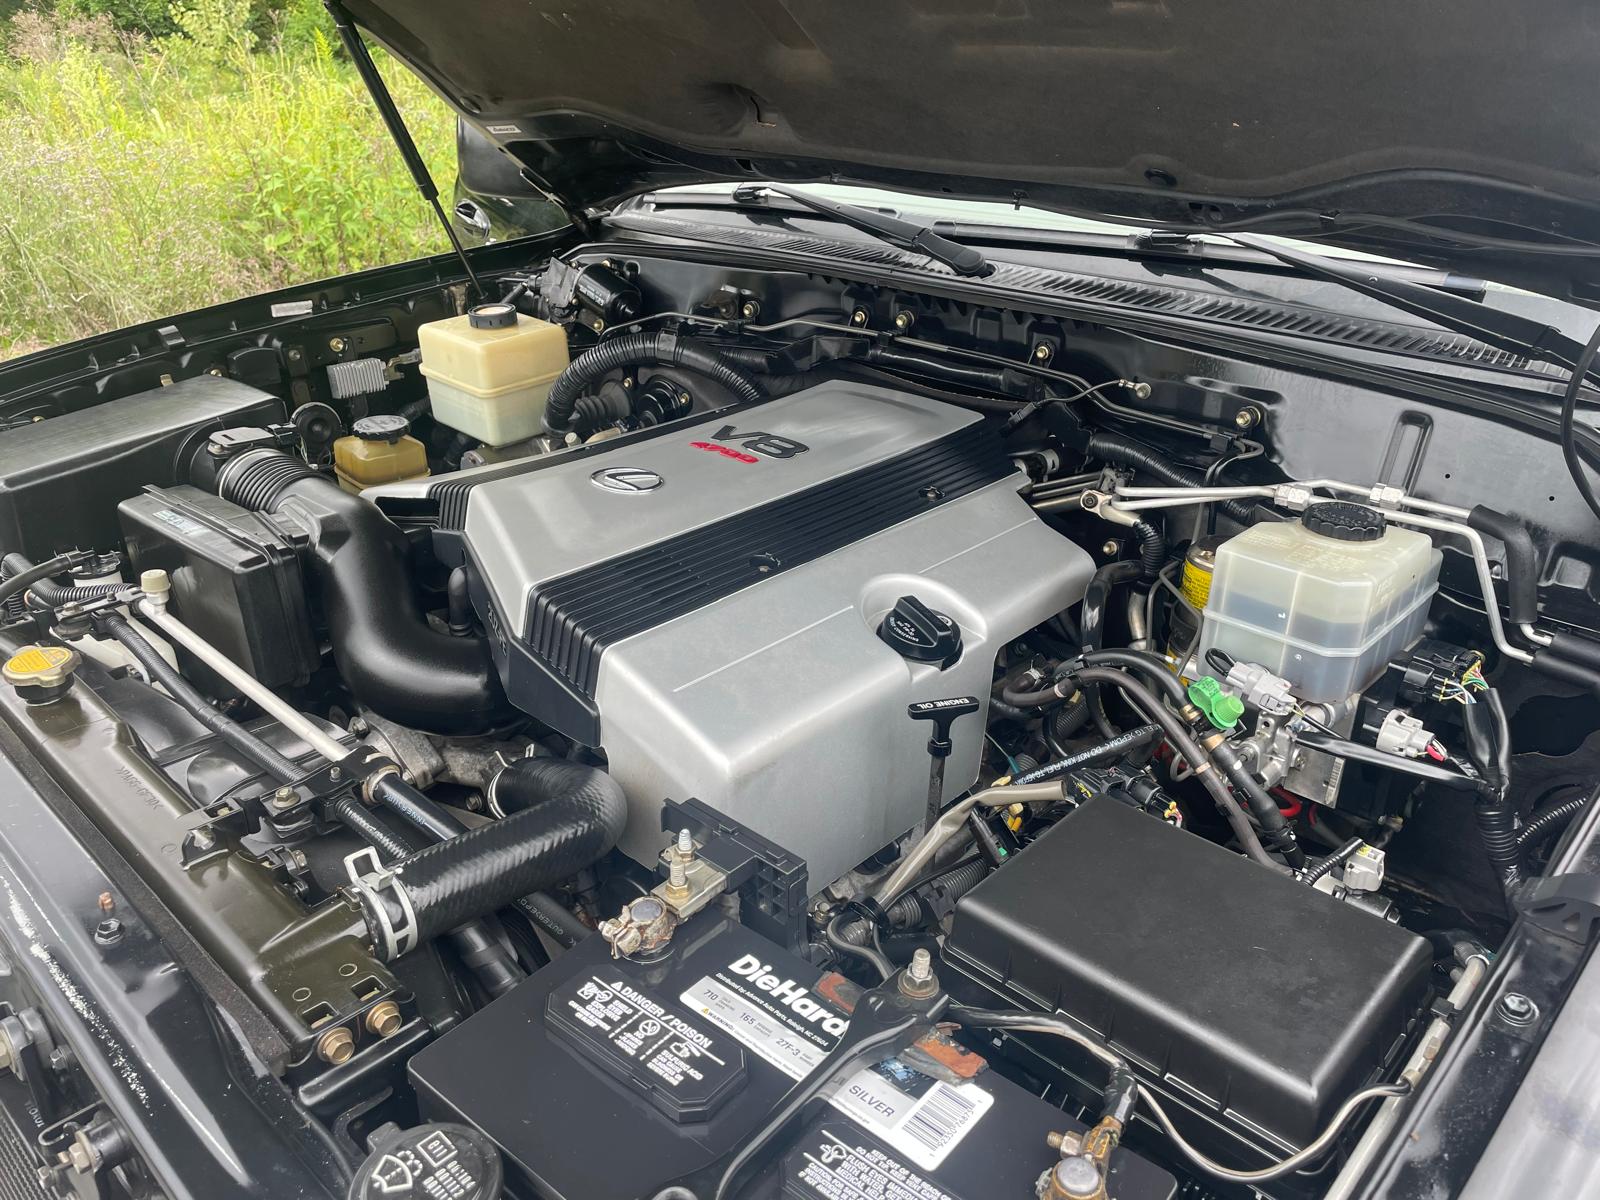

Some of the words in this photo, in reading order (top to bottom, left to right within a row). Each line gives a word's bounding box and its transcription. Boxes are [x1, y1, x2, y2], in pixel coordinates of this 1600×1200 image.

[710, 424, 810, 460] V8
[916, 702, 934, 710] OIL
[933, 697, 970, 708] ENGINE
[704, 989, 719, 1001] 710
[728, 953, 850, 1037] DieHard
[740, 1012, 756, 1025] 165
[848, 1085, 896, 1117] SILVER
[835, 1166, 866, 1191] MEDICAL
[841, 1160, 860, 1177] WITH
[845, 1154, 871, 1174] FLUSH
[868, 1168, 888, 1185] EYES
[423, 1176, 453, 1200] 00111
